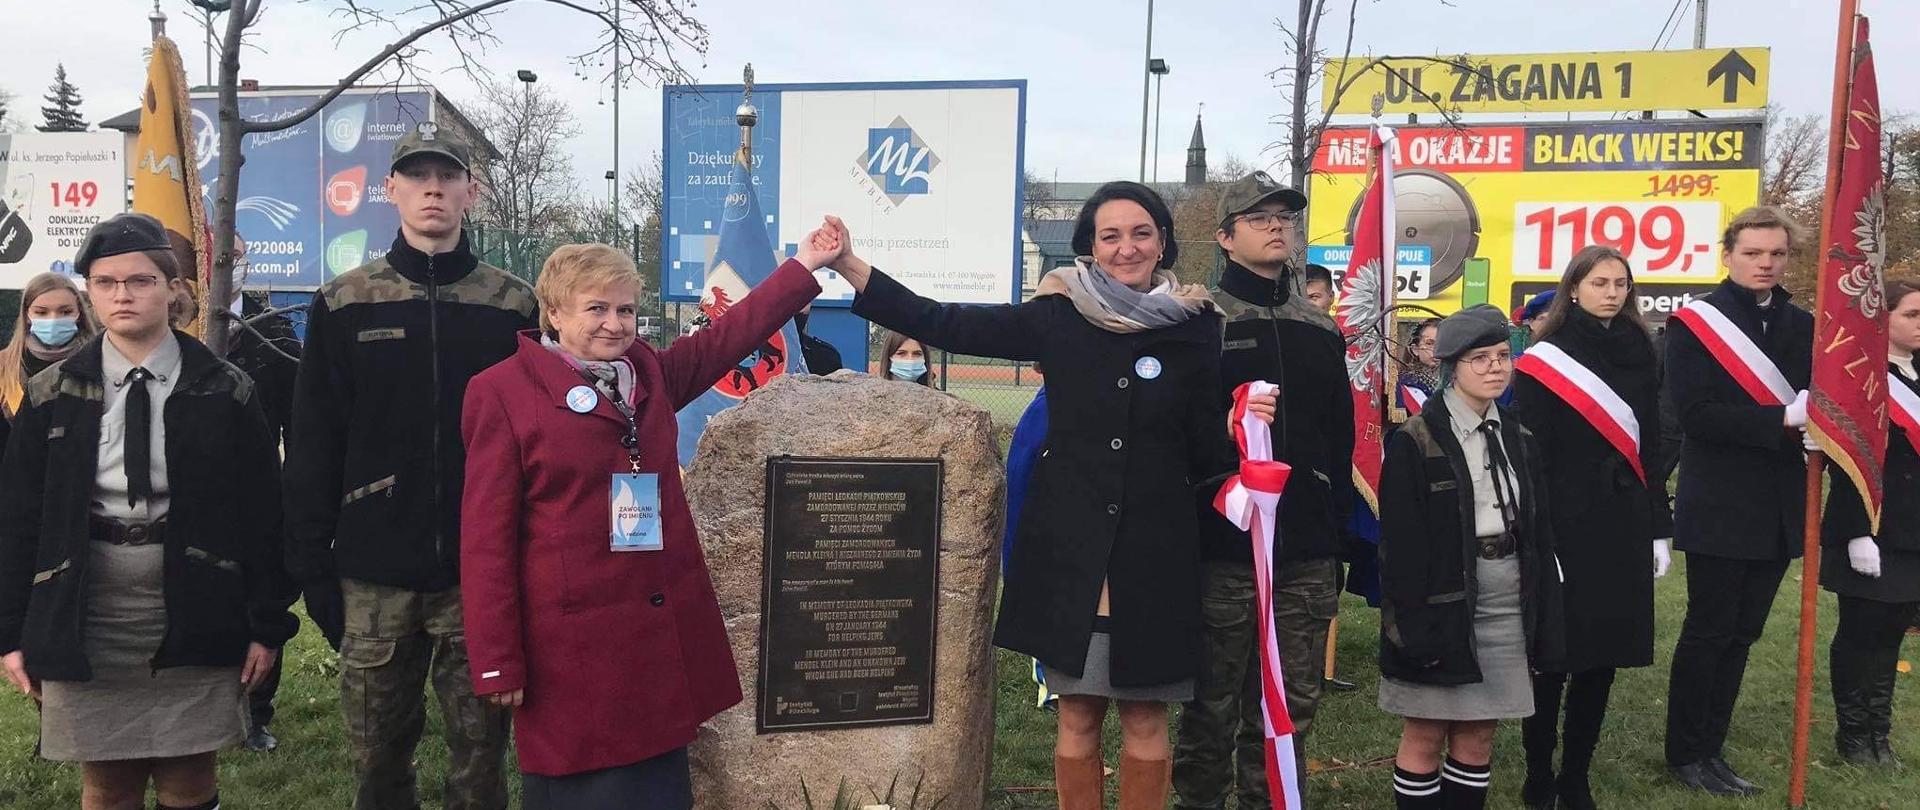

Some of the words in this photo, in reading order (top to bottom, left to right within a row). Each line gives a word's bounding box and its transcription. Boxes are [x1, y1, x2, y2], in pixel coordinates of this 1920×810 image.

[1385, 66, 1441, 103] UL.
[1614, 62, 1632, 99] 1
[367, 123, 406, 133] internet
[1327, 137, 1402, 166] MEA
[1409, 135, 1512, 165] OKAZJE
[1535, 133, 1624, 164] BLACK
[1632, 130, 1743, 162] WEEKS!
[34, 151, 64, 165] Jerzego
[112, 151, 117, 161] 1
[688, 151, 764, 168] Dziękujmy
[688, 175, 701, 185] za
[705, 171, 763, 185] zaufe.
[51, 181, 98, 207] 149
[368, 184, 386, 195] tele
[48, 216, 100, 225] ODKURZACZ
[47, 227, 90, 236] ELEKTRYCZ
[1525, 205, 1709, 272] 1199,-
[58, 238, 71, 247] DO
[245, 241, 304, 255] 7920084
[852, 237, 883, 249] twoja
[887, 236, 950, 252] przestrzeń
[1324, 250, 1352, 261] ODKU
[1638, 293, 1693, 314] pert
